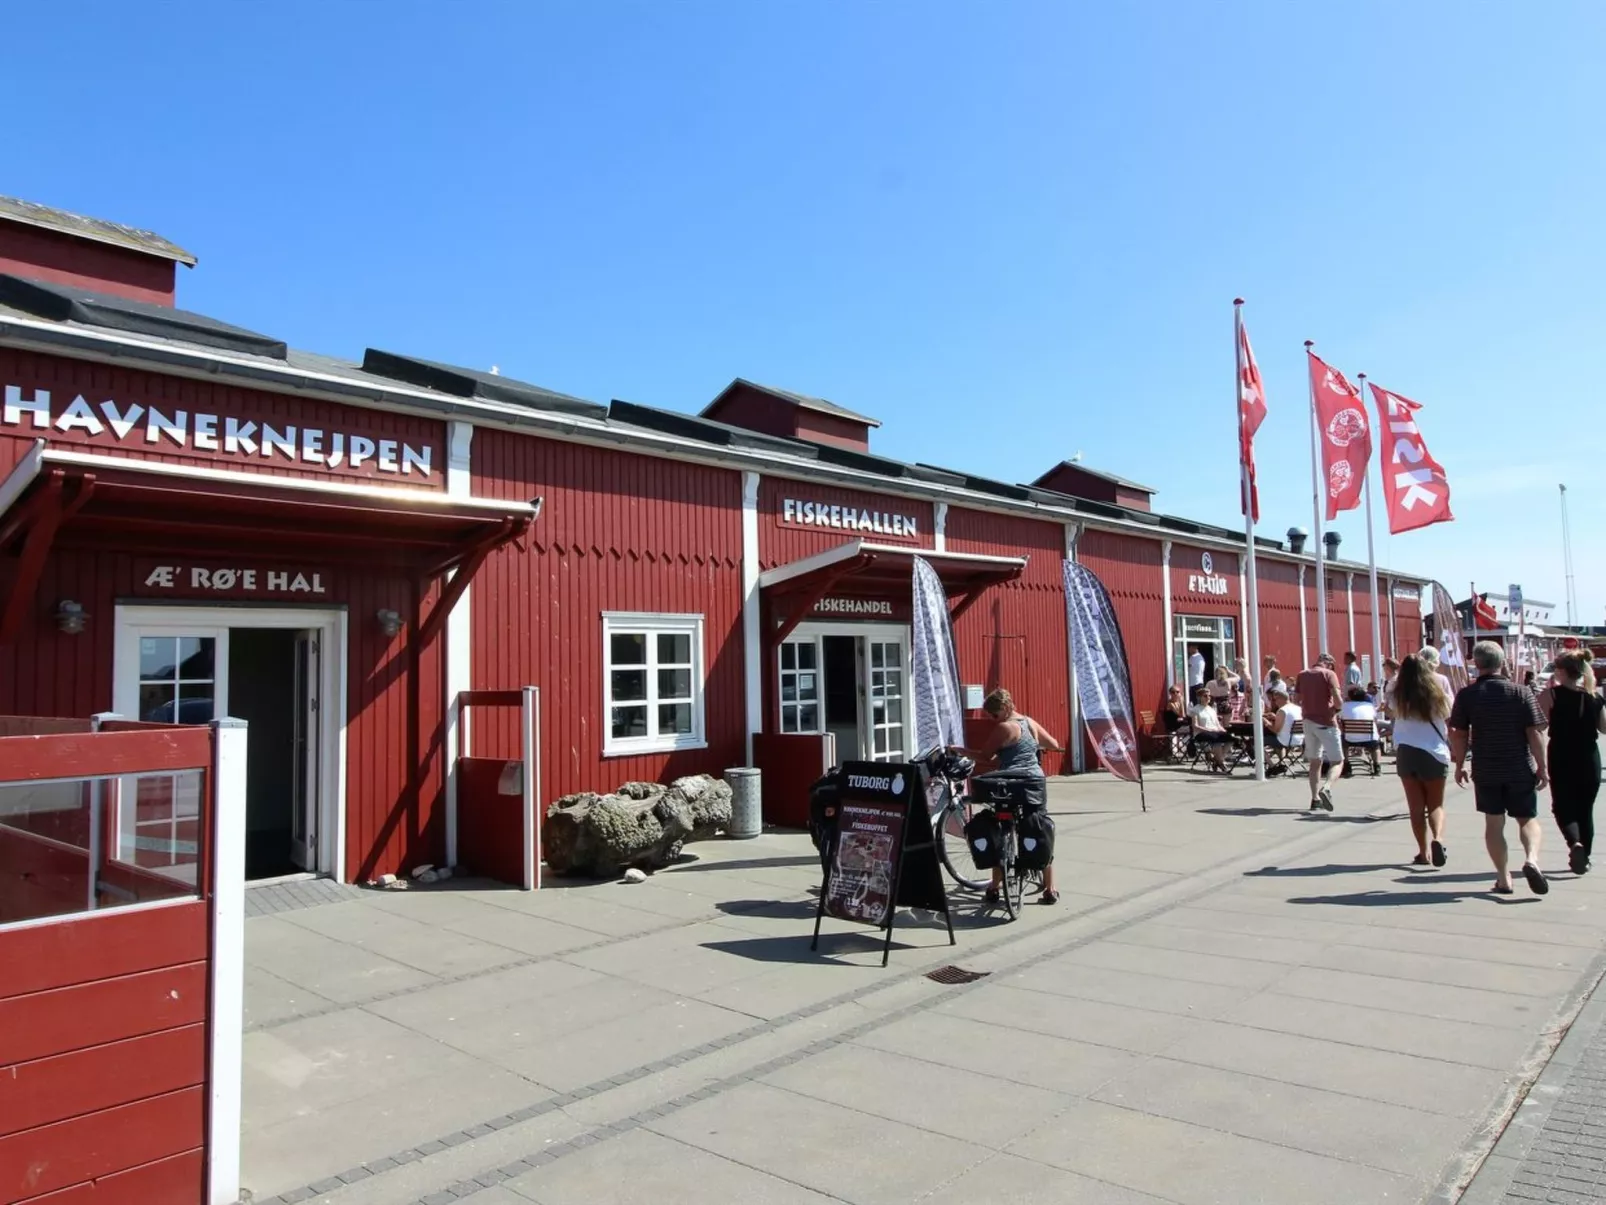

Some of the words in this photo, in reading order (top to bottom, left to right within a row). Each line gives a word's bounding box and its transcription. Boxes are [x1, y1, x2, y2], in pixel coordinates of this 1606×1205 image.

[3, 385, 433, 477] HAVNEKNEJPEN
[783, 498, 917, 537] FISKEHALLEN
[191, 567, 257, 590] RØ'E
[267, 571, 325, 593] HAL
[848, 775, 890, 790] TUBORG
